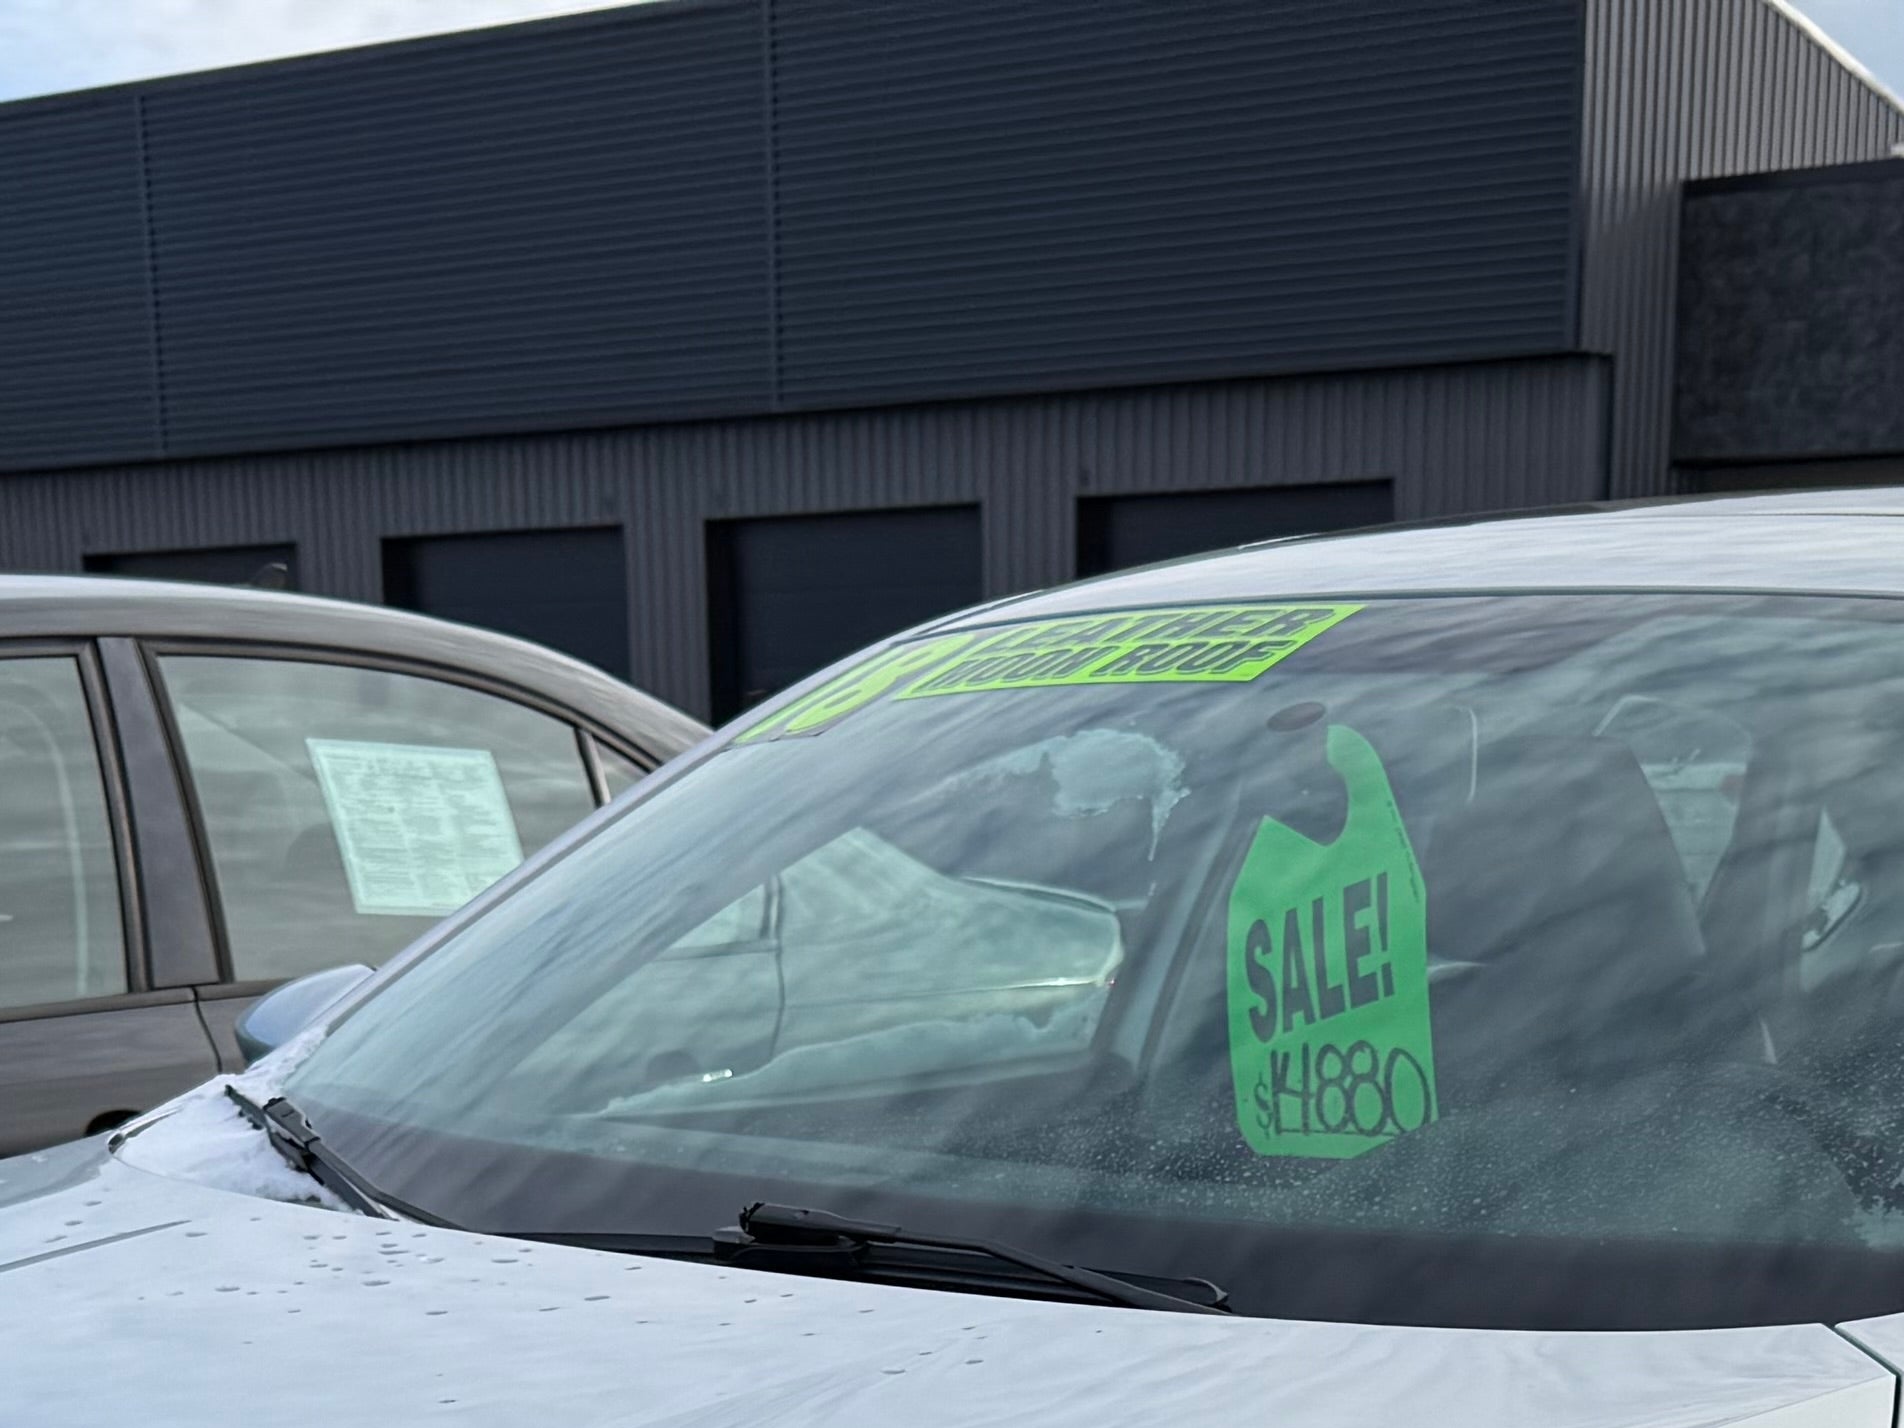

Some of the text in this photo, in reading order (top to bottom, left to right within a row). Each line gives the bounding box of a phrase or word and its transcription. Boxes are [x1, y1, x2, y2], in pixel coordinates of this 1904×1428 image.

[968, 607, 1336, 654] LEATHER
[930, 639, 1297, 690] MOON ROOF
[1245, 871, 1395, 1043] SALE!
